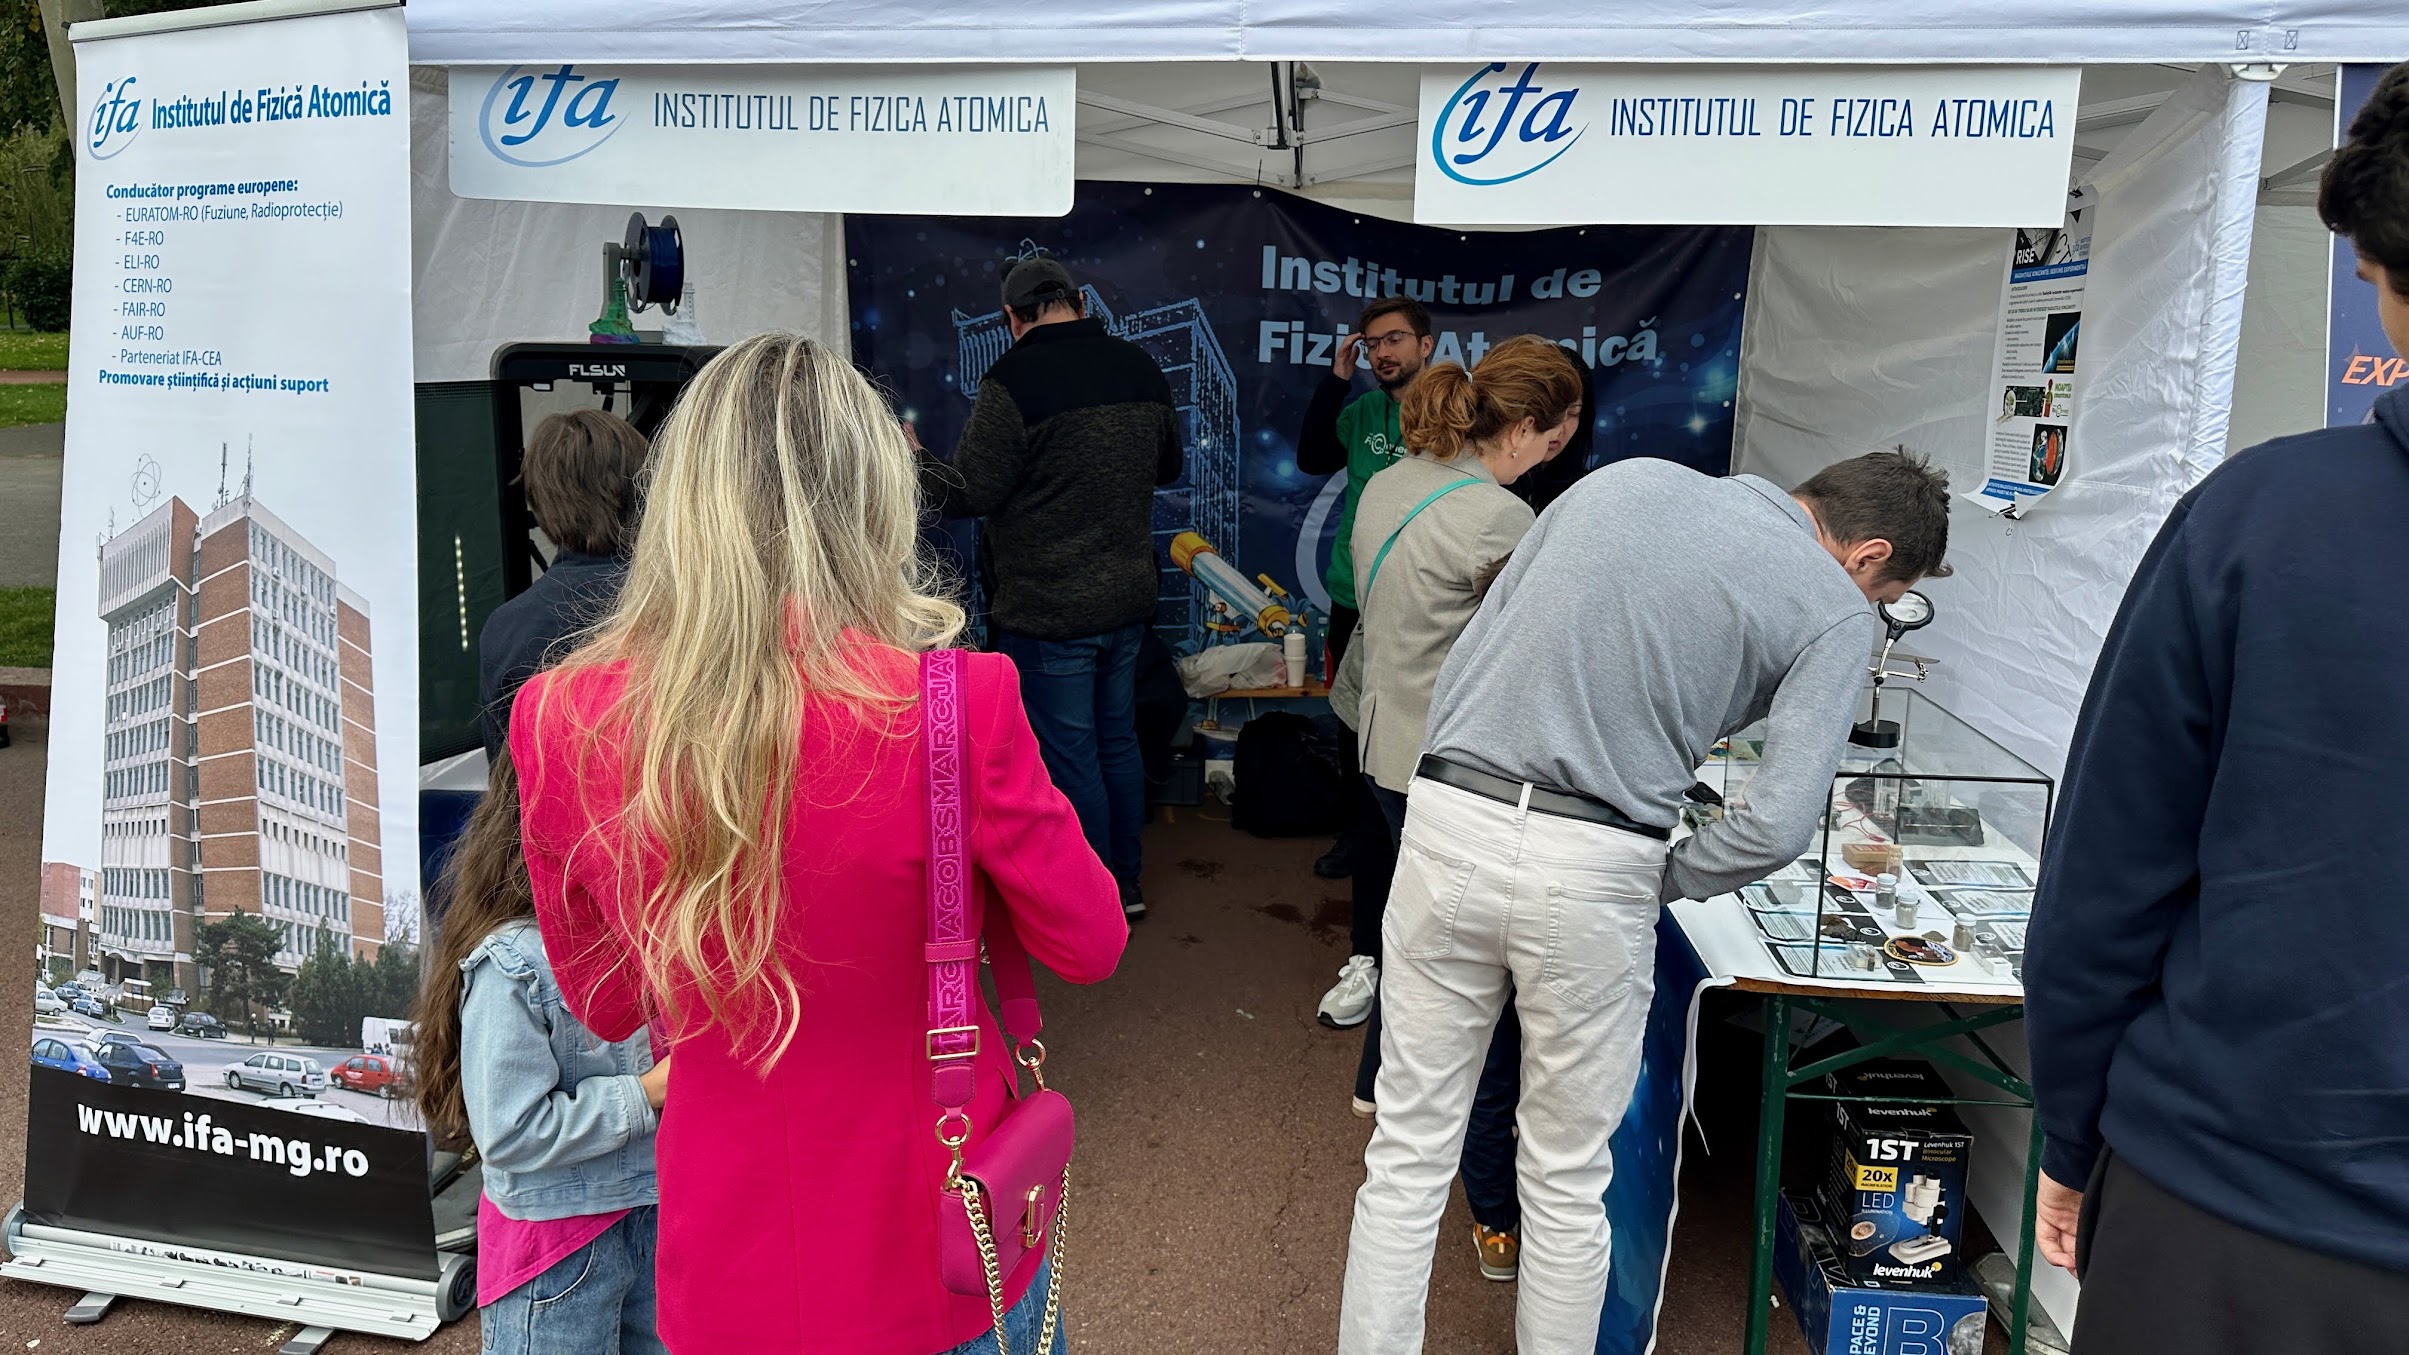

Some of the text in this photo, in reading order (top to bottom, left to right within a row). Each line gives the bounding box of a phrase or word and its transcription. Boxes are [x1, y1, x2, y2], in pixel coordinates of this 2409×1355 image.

[93, 76, 141, 148] ifa
[152, 80, 391, 129] Institutul de Fizică Atomică
[500, 64, 620, 146] ifa
[654, 92, 1049, 133] INSTITUTUL DE FIZICA ATOMICA
[1453, 62, 1579, 165] ifa
[1611, 98, 2054, 138] INSTITUTUL DE FIZICA ATOMICA
[106, 179, 299, 200] Conducător programe europene:
[126, 206, 198, 222] EURATOM-RO
[201, 204, 249, 222] (Fuziune,
[125, 231, 164, 246] F4E-RO
[124, 254, 160, 269] ELI-RO
[2016, 248, 2035, 264] RISE
[1262, 245, 1602, 305] Institutul de
[123, 278, 172, 293] CERN-RO
[122, 302, 166, 317] FAIR-RO
[121, 325, 164, 340] AUF-RO
[1431, 315, 1657, 371] Atică
[120, 348, 222, 366] Parteneriat IFA-CEA
[568, 364, 626, 377] FLSUN
[99, 369, 164, 386] Promovare
[280, 377, 329, 395] suport
[1868, 1107, 1932, 1116] levenhuk
[77, 1103, 369, 1177] www.ifa-mg.ro
[1924, 1141, 1954, 1149] Levenhuk
[1866, 1138, 1919, 1161] 1ST
[1921, 1155, 1957, 1163] Microscope
[1862, 1169, 1893, 1183] 20x
[1862, 1192, 1895, 1209] LED
[1873, 1263, 1933, 1279] levenhuk
[1849, 1318, 1865, 1355] PACE
[1863, 1306, 1881, 1355] EYOND
